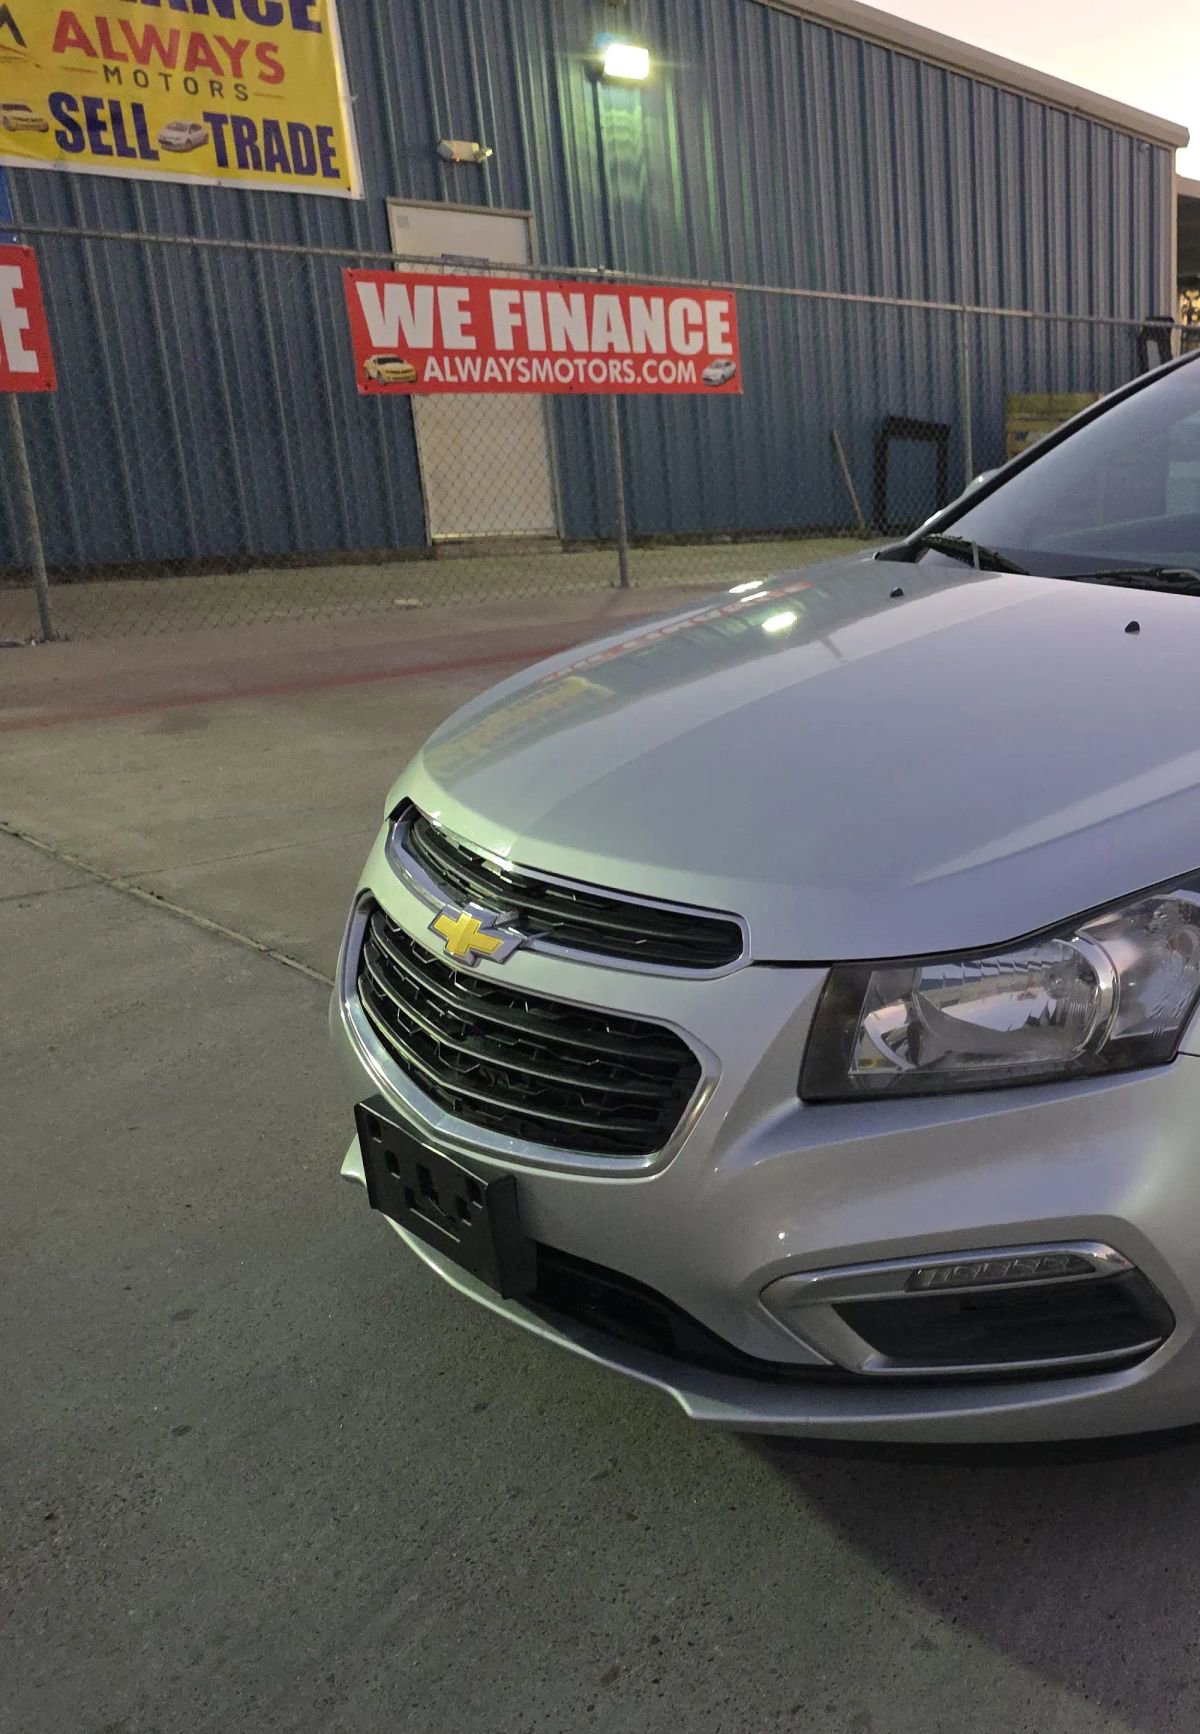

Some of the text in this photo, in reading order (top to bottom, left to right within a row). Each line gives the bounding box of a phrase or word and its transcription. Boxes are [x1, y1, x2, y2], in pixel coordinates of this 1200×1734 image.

[52, 10, 285, 85] ALWAYS
[102, 64, 249, 101] MOTORS
[48, 91, 341, 179] SELL TRADE
[356, 281, 734, 356] WE FINANCE
[423, 355, 697, 384] ALWAYSMOTORS.COM
